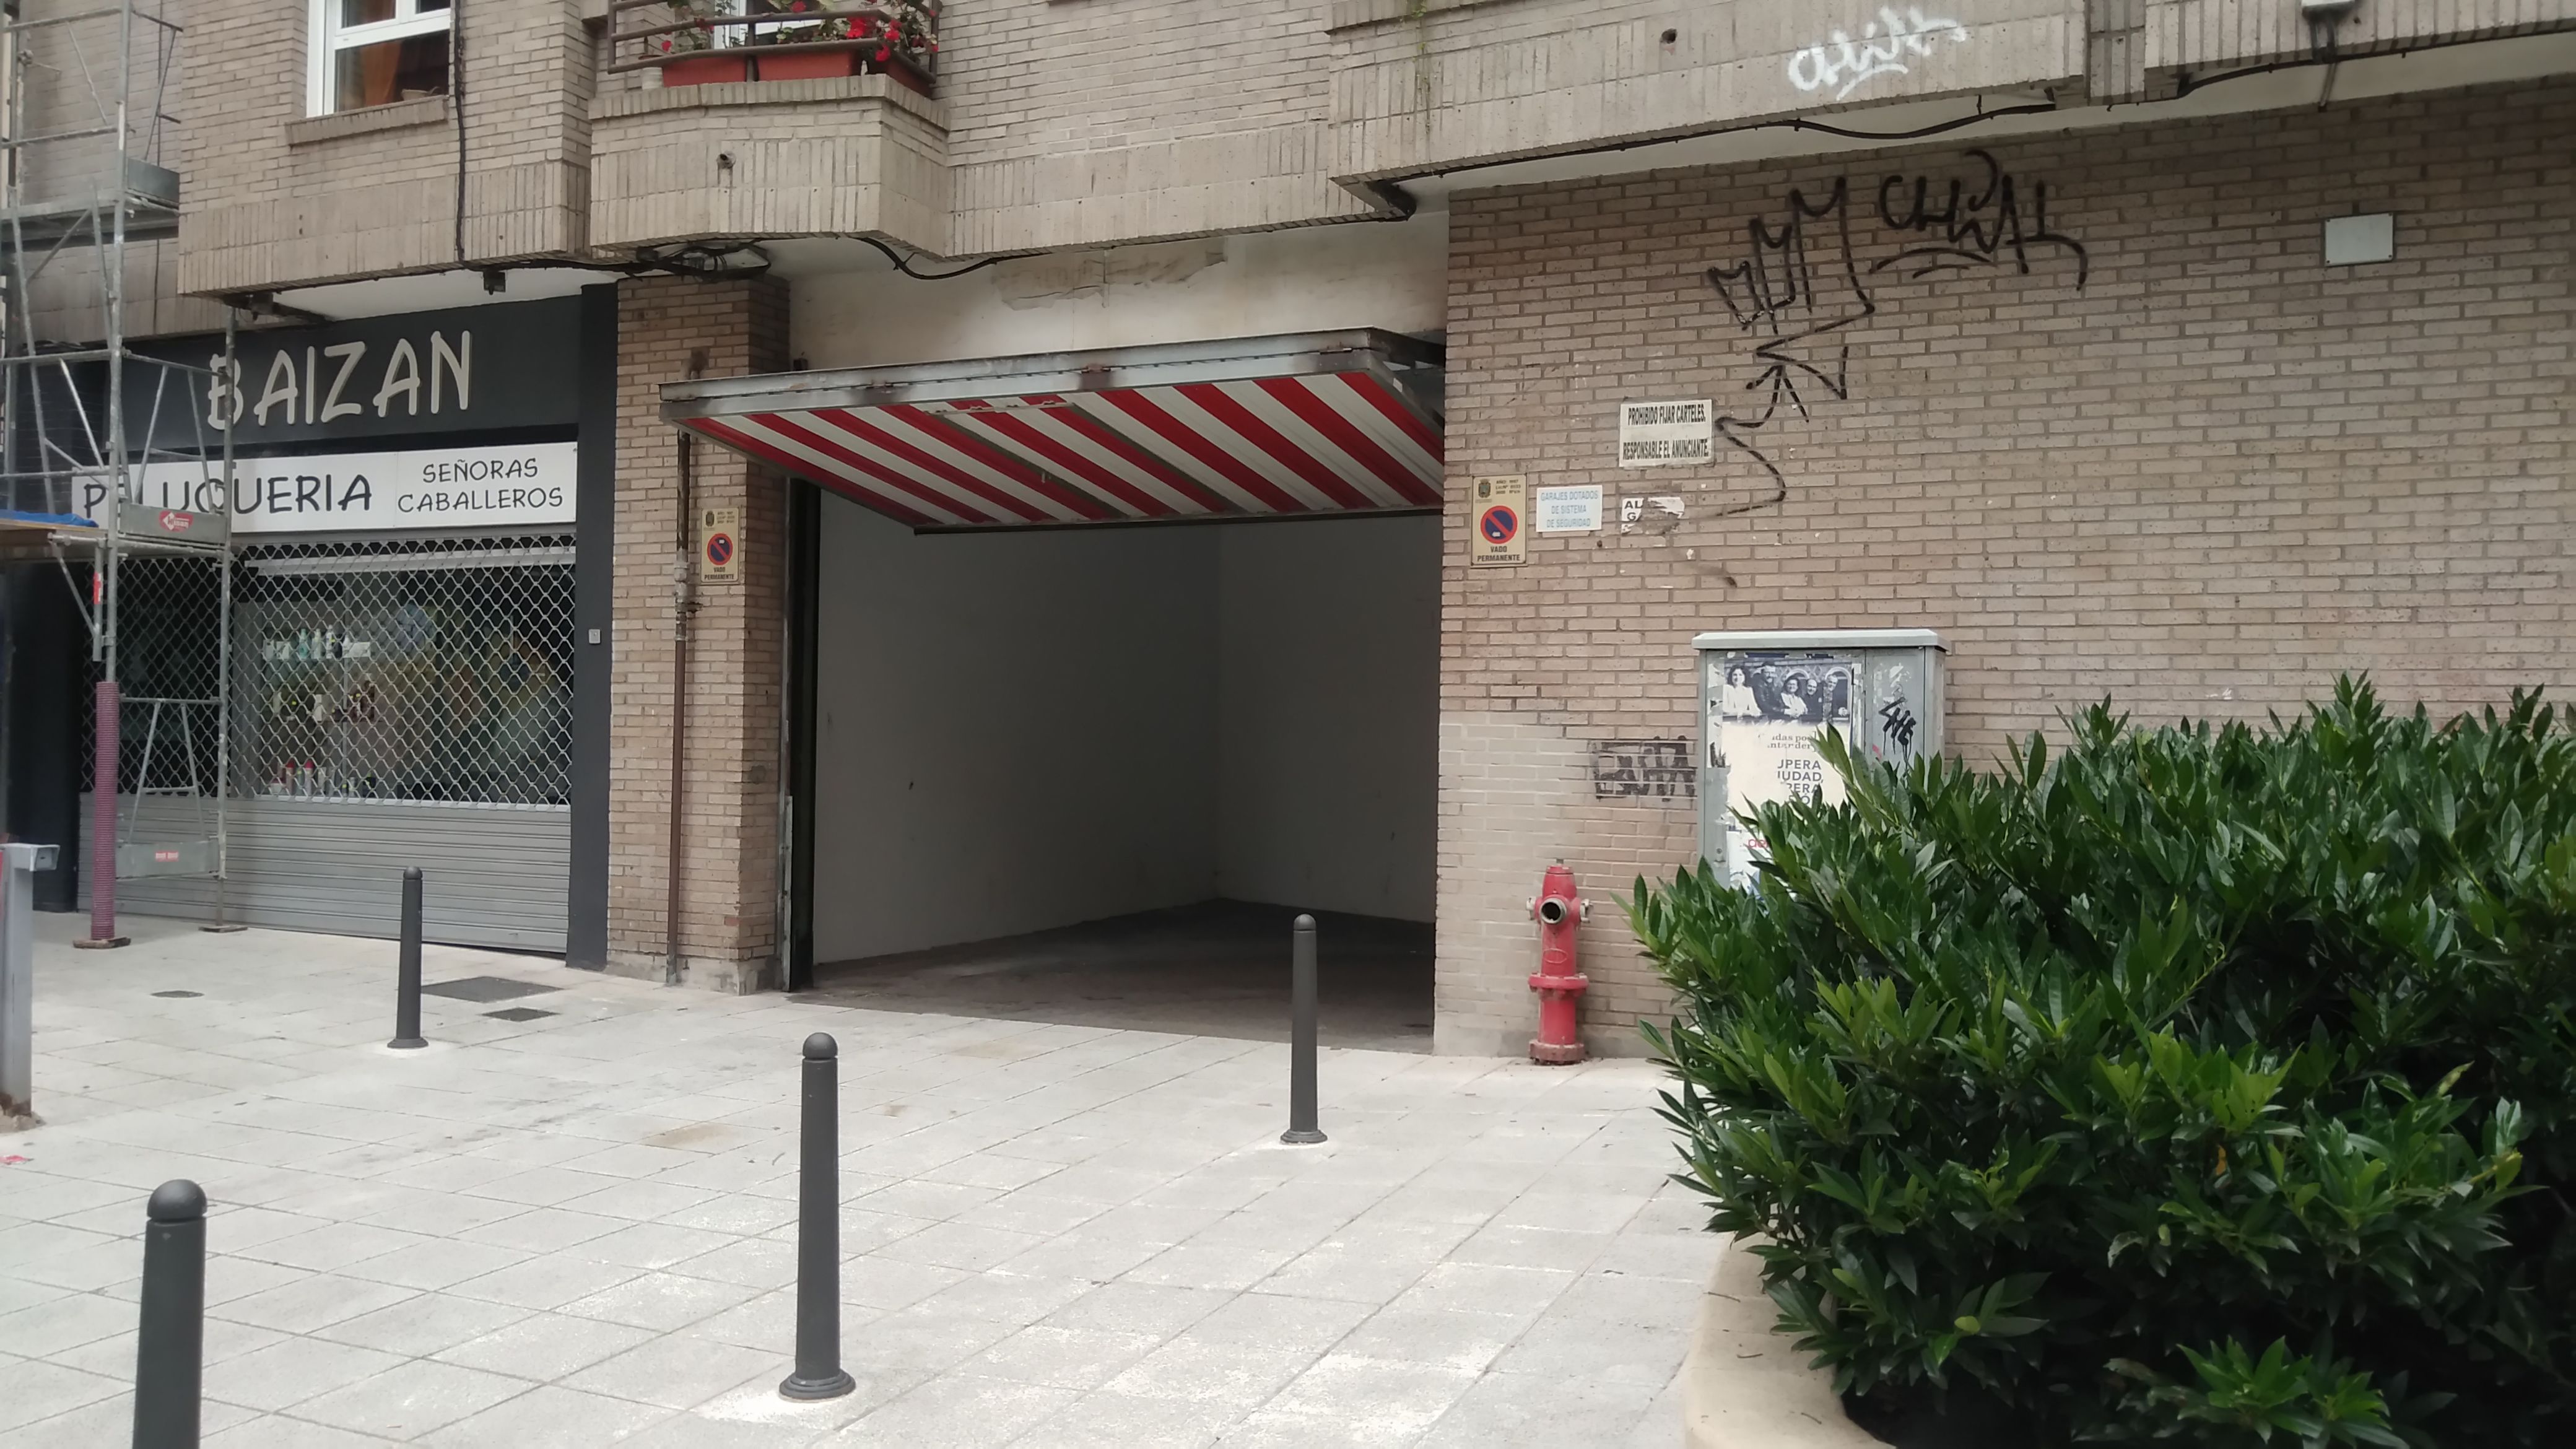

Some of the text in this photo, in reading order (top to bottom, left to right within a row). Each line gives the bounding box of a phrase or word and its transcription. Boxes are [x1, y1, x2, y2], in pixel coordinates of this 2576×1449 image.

[207, 330, 472, 430] BAIZAN
[1628, 404, 1706, 425] PROHIBIDO FIJAR CARTELES.
[1623, 438, 1709, 460] RESPONSABLE EL ANUNCIANTE.
[423, 458, 537, 483] SEÑORAS
[398, 487, 563, 513] CABALLEROS
[1541, 490, 1598, 501] GARAJES DOTADOS
[1551, 505, 1586, 515] DE SISTEMA
[1546, 518, 1591, 528] DE SEGURIDAD
[1777, 771, 1824, 783] IUDAD,
